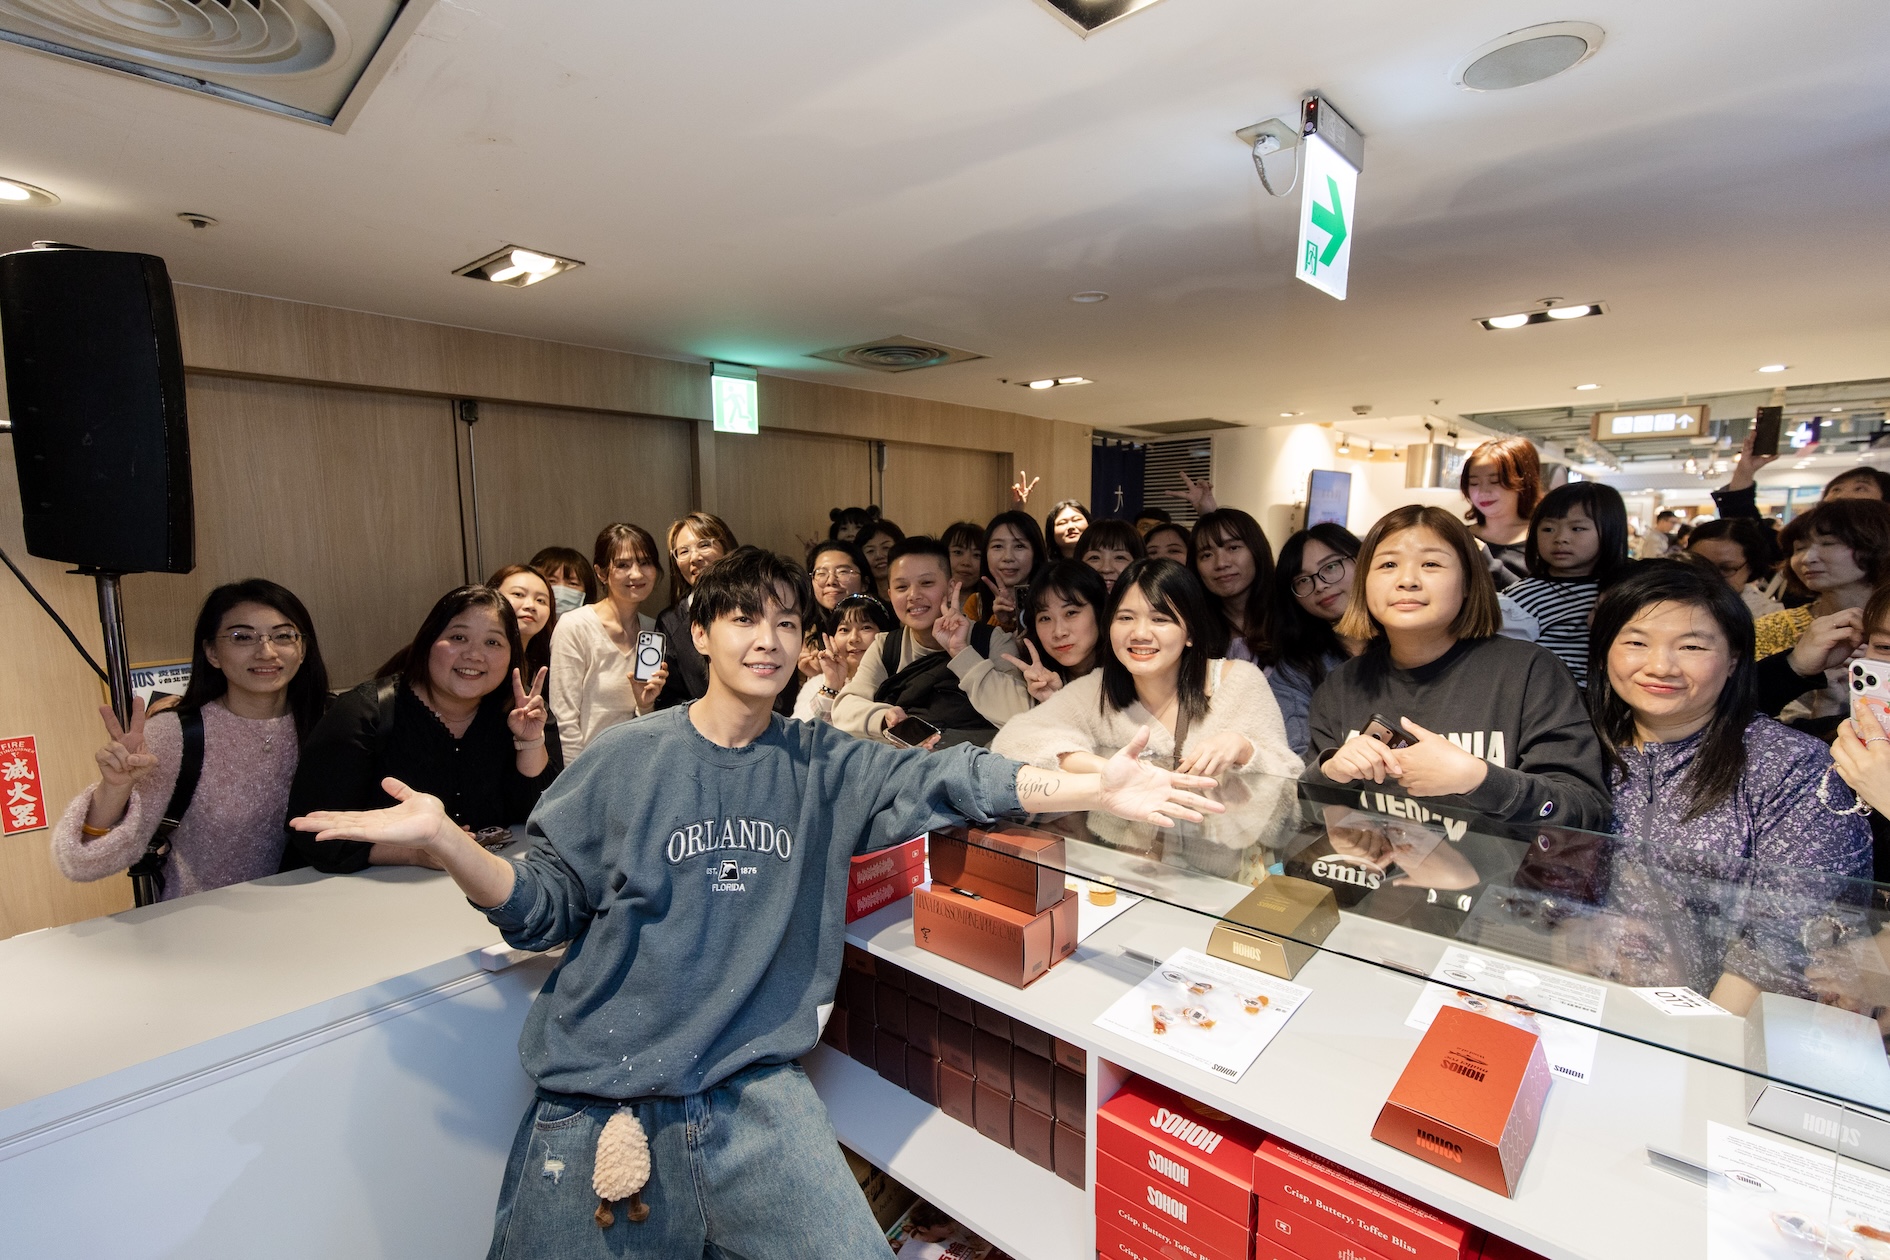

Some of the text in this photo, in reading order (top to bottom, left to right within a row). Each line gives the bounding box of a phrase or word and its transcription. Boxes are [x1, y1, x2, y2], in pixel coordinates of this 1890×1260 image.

[130, 670, 155, 689] HOS
[0, 747, 36, 757] TINGUISHER
[1, 740, 25, 750] FIRE
[1, 757, 39, 829] 滅火器
[666, 817, 793, 864] ORLANDO
[706, 867, 718, 875] EST.
[711, 883, 746, 892] FLORIDA
[1311, 857, 1383, 890] emis
[1232, 941, 1262, 962] HOHOS
[1416, 1128, 1463, 1164] HOHOS
[1802, 1112, 1862, 1147] HOHOS
[1118, 1208, 1141, 1228] Crisp,
[1142, 1221, 1172, 1245] Buttery,
[1172, 1238, 1198, 1260] Toffee
[1283, 1184, 1313, 1205] Crisp,
[1315, 1197, 1355, 1226] Buttery,
[1356, 1218, 1389, 1241] Toffee
[1391, 1235, 1418, 1256] Bliss
